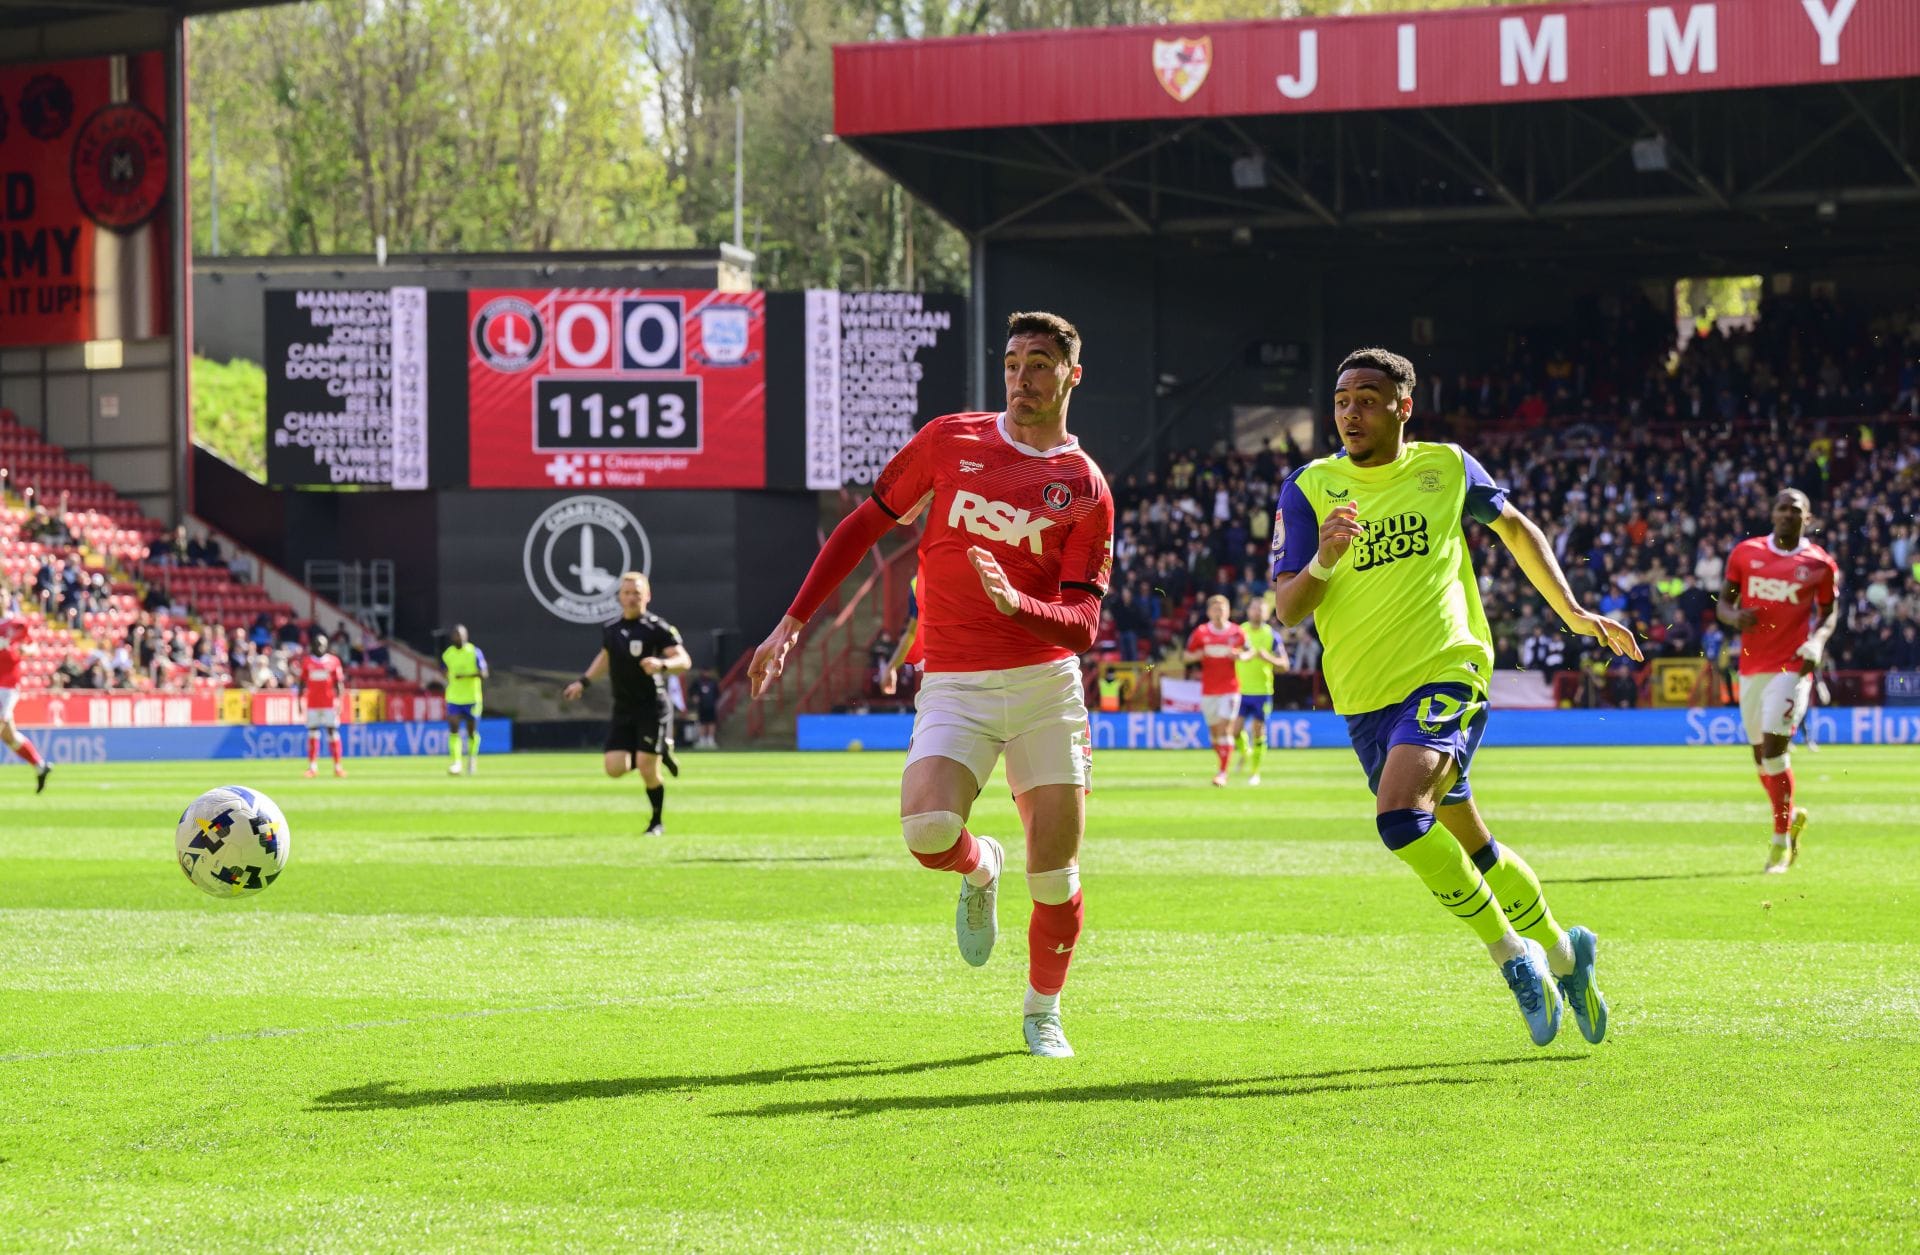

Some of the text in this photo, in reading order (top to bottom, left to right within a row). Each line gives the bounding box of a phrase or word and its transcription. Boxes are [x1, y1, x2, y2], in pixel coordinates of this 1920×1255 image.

[1276, 0, 1857, 99] JIMMY
[0, 172, 35, 221] D
[10, 285, 81, 315] IT UP!
[296, 290, 391, 308] MANNION
[841, 294, 922, 311] IVERSEN
[311, 309, 391, 326] RAMSAY
[841, 311, 950, 329] WHITEMAN
[328, 326, 391, 344] JONES
[556, 303, 679, 367] 0 0
[288, 343, 391, 361] CAMPBELL
[286, 361, 391, 379] DOCHERTY
[327, 378, 391, 396] CAREY
[346, 396, 391, 412] BELL
[284, 412, 391, 430] CHAMBERS
[550, 393, 686, 438] 11:13
[275, 428, 391, 447] R-COSTELLO
[605, 455, 689, 471] Christopher
[959, 459, 984, 470] Reebok
[331, 465, 391, 483] DYKES
[605, 471, 645, 484] Ward
[948, 489, 1056, 555] RSK
[1352, 511, 1427, 547] SPUD
[1353, 531, 1429, 571] BROS
[1747, 576, 1803, 605] RSK
[1783, 698, 1795, 721] 2
[348, 722, 401, 755] Flux
[1127, 711, 1203, 749] Flux
[31, 729, 107, 764] Vans
[1502, 899, 1524, 915] NE
